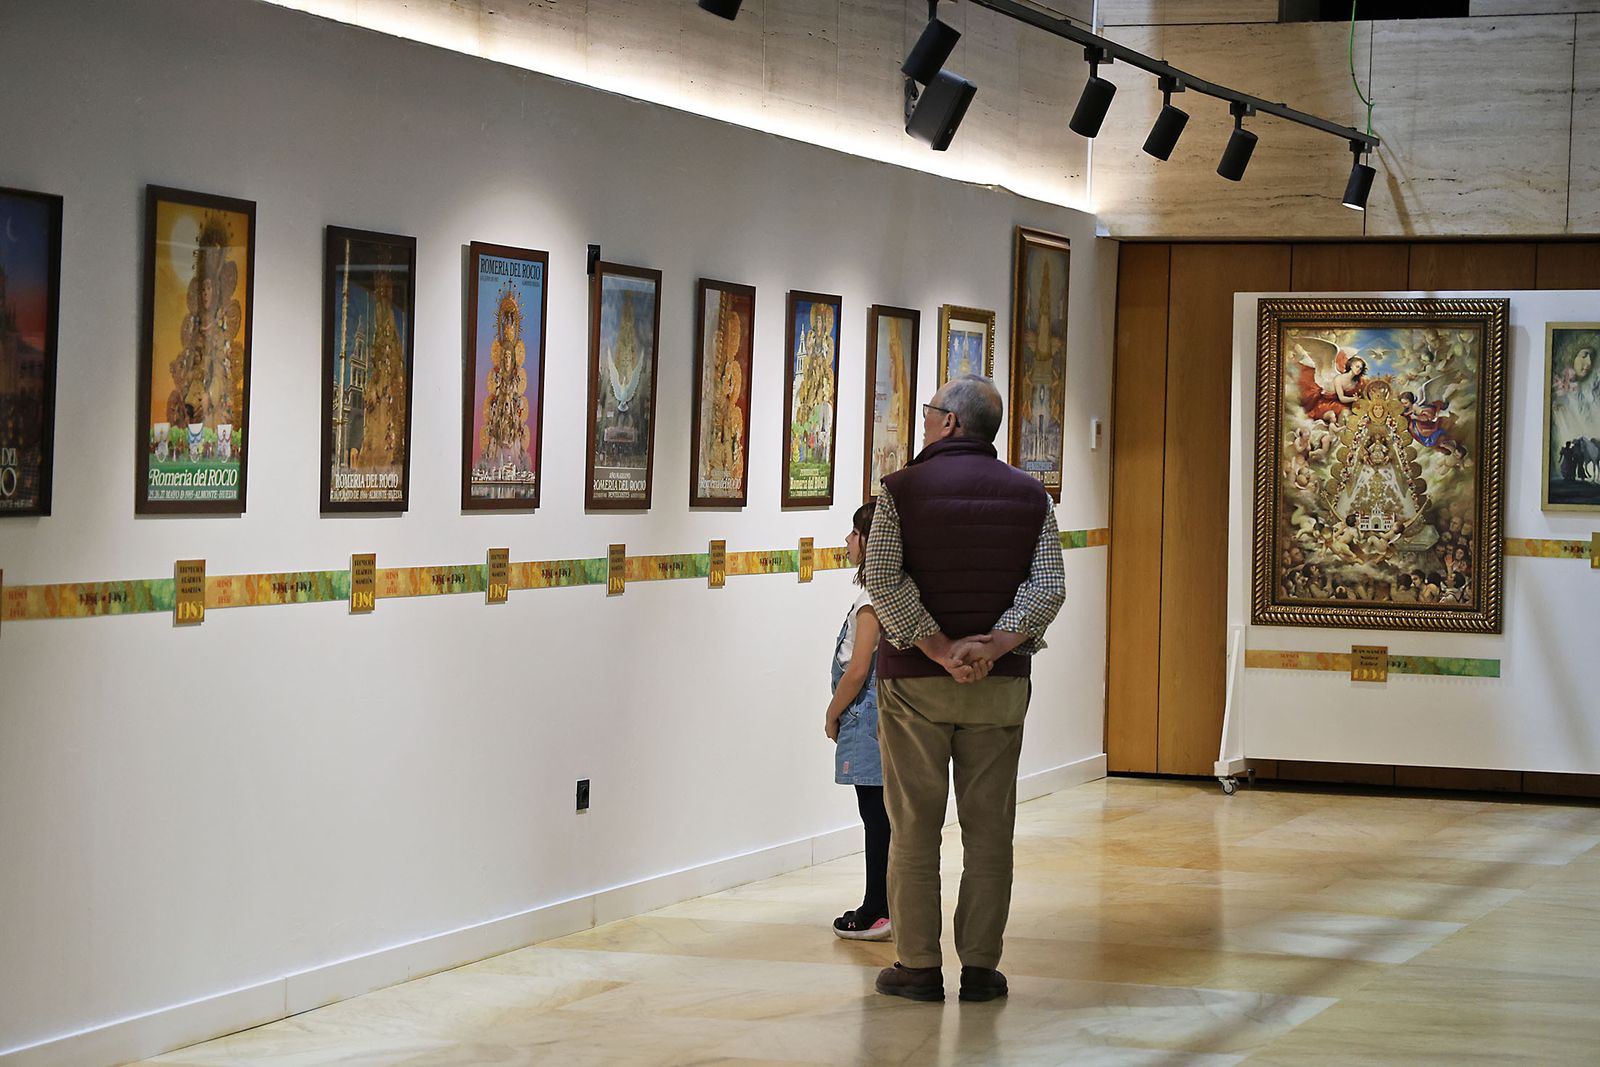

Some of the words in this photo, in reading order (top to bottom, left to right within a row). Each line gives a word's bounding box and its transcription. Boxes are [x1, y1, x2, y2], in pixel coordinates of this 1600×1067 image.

[480, 258, 508, 276] ROMERIA
[510, 262, 521, 277] DEL
[522, 264, 540, 280] ROCIO
[149, 468, 192, 486] Romeria
[193, 469, 207, 486] del
[208, 469, 237, 486] ROCIO
[335, 473, 365, 488] ROMERIA
[366, 474, 378, 488] DEL
[379, 474, 398, 488] ROCIO
[352, 591, 374, 608] 1986
[489, 584, 508, 598] 1987
[178, 601, 204, 619] 1985
